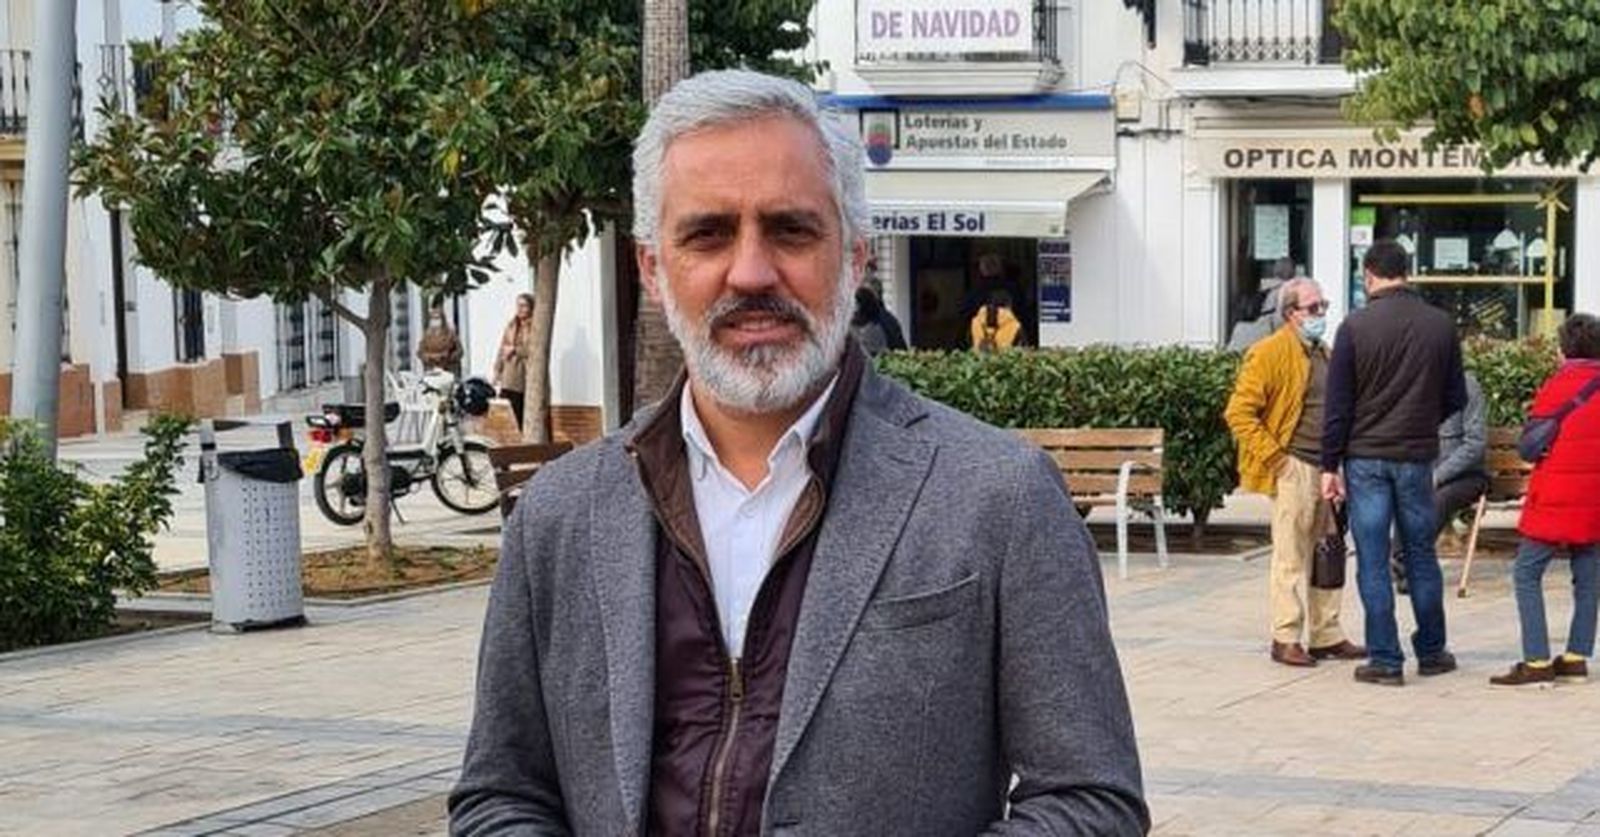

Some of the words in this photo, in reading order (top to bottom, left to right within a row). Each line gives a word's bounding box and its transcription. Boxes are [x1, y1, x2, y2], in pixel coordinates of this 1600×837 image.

[871, 10, 903, 39] DE
[911, 8, 1021, 38] NAVIDAD
[973, 117, 983, 133] y
[906, 133, 979, 150] Apuestas
[983, 133, 1008, 149] del
[1011, 132, 1068, 148] Estado
[1224, 148, 1337, 169] OPTICA
[927, 211, 946, 231] El
[954, 211, 985, 231] Sol
